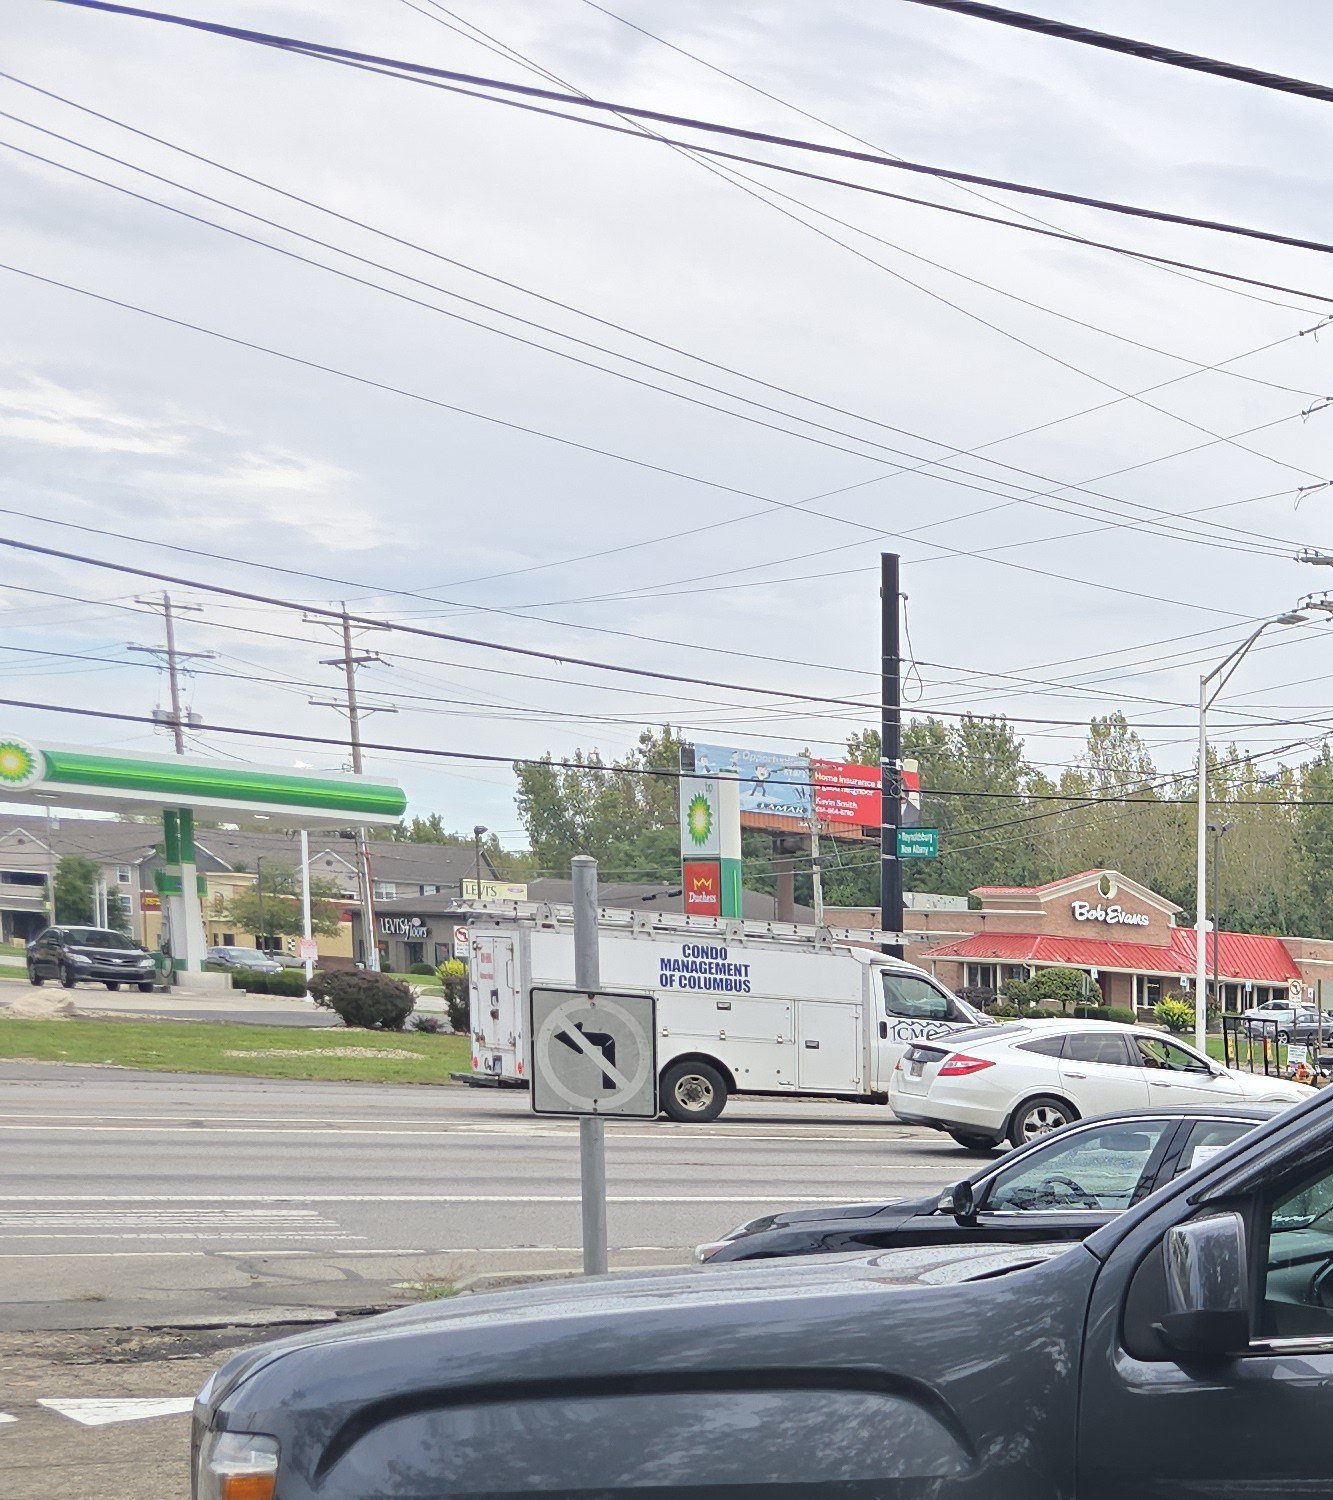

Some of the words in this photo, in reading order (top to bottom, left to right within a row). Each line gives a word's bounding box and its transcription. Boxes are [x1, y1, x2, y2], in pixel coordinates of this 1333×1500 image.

[814, 771, 838, 783] Home
[839, 775, 876, 788] Insurance
[836, 800, 858, 809] Smith
[688, 891, 717, 904] Duchess
[1071, 900, 1106, 921] Bob
[1105, 905, 1150, 926] Evans
[682, 943, 728, 961] CONDO
[659, 957, 751, 978] MANAGEMENT
[659, 972, 676, 988] OF
[678, 974, 751, 993] COLUMBUS
